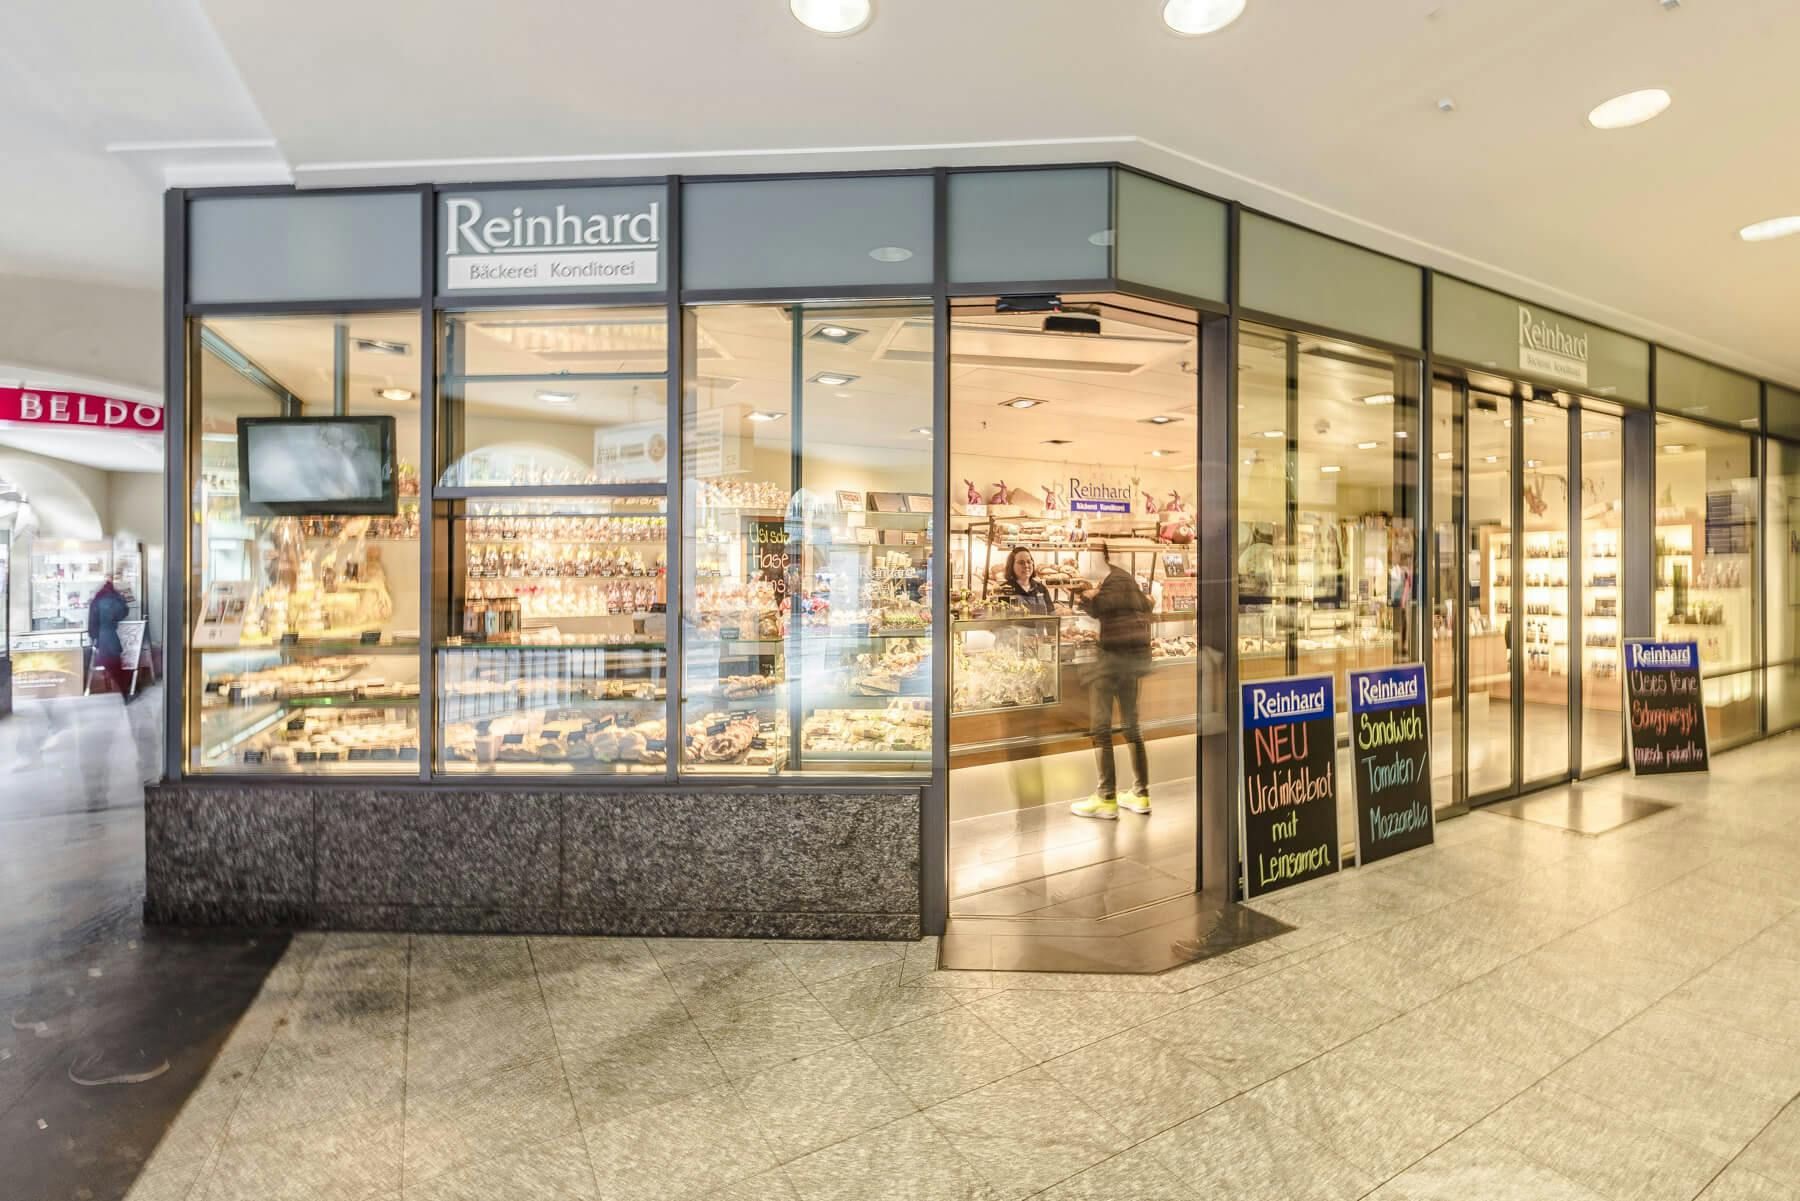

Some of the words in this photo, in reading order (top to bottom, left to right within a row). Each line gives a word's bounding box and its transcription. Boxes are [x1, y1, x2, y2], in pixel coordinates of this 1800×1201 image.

[446, 198, 659, 255] Reinhard
[470, 263, 537, 280] Bäckerei
[550, 260, 635, 278] Konditorei
[1519, 304, 1588, 360] Reinhard
[1070, 478, 1131, 499] Reinhard
[1632, 643, 1691, 667] Reinhard
[1253, 687, 1324, 720] Reinhard
[1359, 675, 1417, 706] Reinhard
[1255, 721, 1308, 767] NEU
[1359, 707, 1423, 750] Sandwich
[1248, 761, 1333, 815] Urdinkelbrot
[1361, 751, 1414, 794] Tomaten
[1272, 810, 1299, 842] mit
[1370, 800, 1428, 843] Mozzarella
[1259, 843, 1331, 887] Leinsamen
